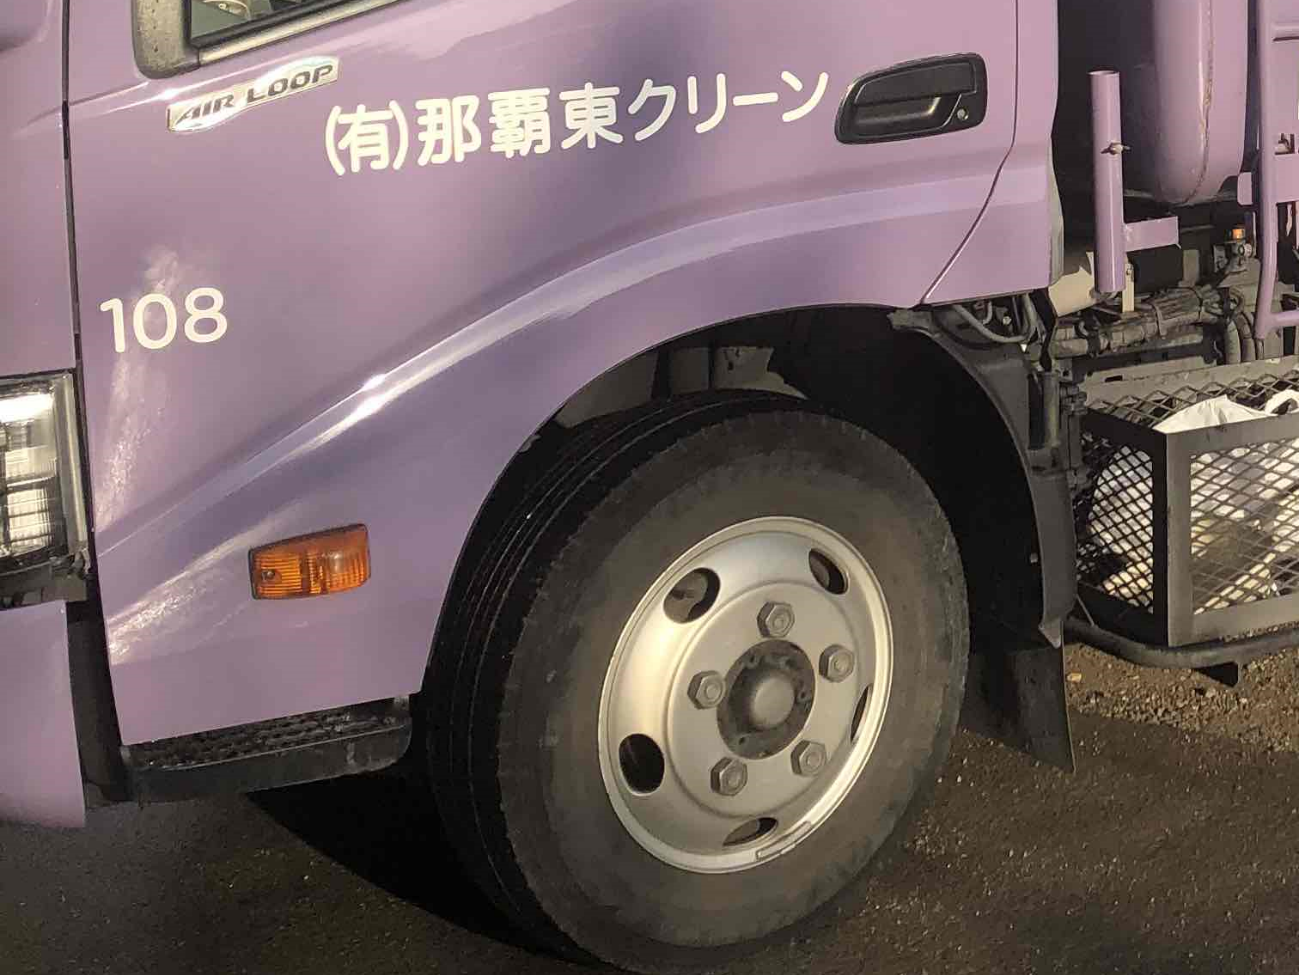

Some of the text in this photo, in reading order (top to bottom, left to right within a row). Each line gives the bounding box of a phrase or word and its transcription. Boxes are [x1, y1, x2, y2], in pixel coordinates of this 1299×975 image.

[174, 64, 334, 125] AIR LOOP
[100, 286, 228, 353] 108
